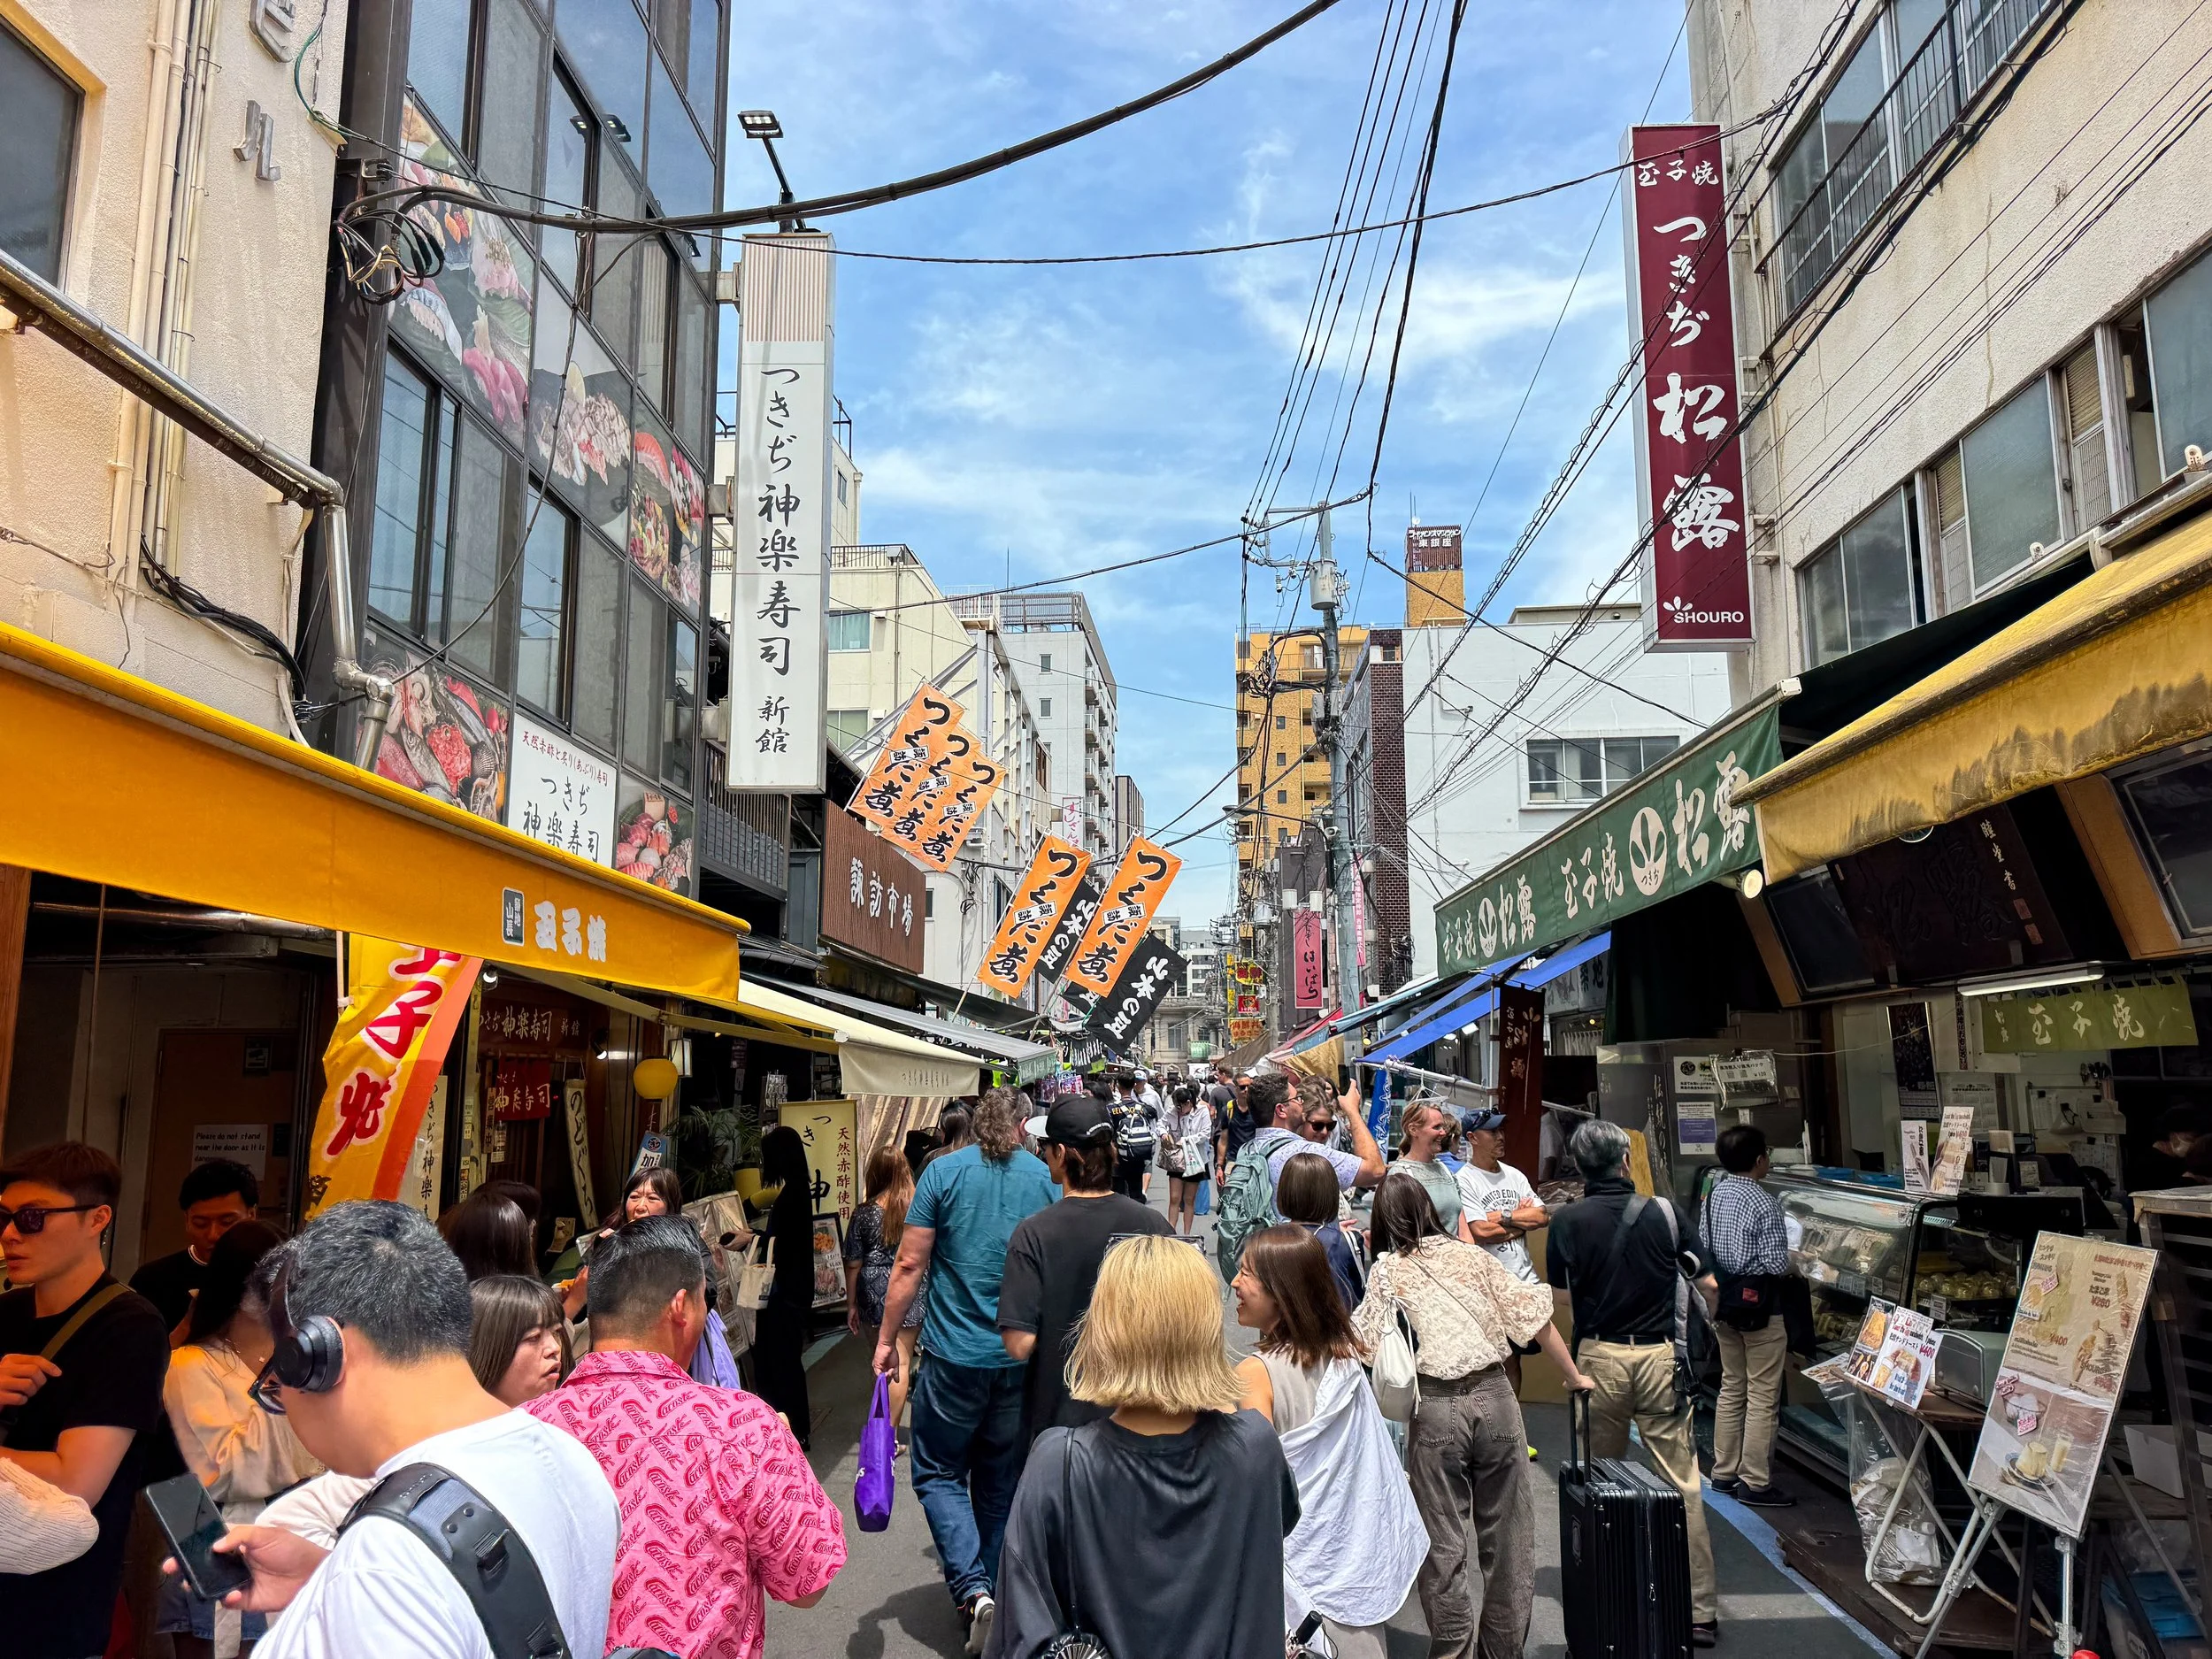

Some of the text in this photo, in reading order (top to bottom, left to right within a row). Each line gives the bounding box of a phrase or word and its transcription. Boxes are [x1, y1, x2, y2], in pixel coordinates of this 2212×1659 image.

[1418, 539, 1452, 548] 東銀座
[1674, 610, 1744, 624] SHOURO
[754, 695, 791, 755] 新館
[541, 775, 590, 816] つきぢ
[523, 801, 601, 864] 神楽寿司
[850, 856, 914, 937] 諏訪市場
[1104, 956, 1171, 1040] 山本の豆
[835, 1126, 851, 1221] 天然赤酢使用
